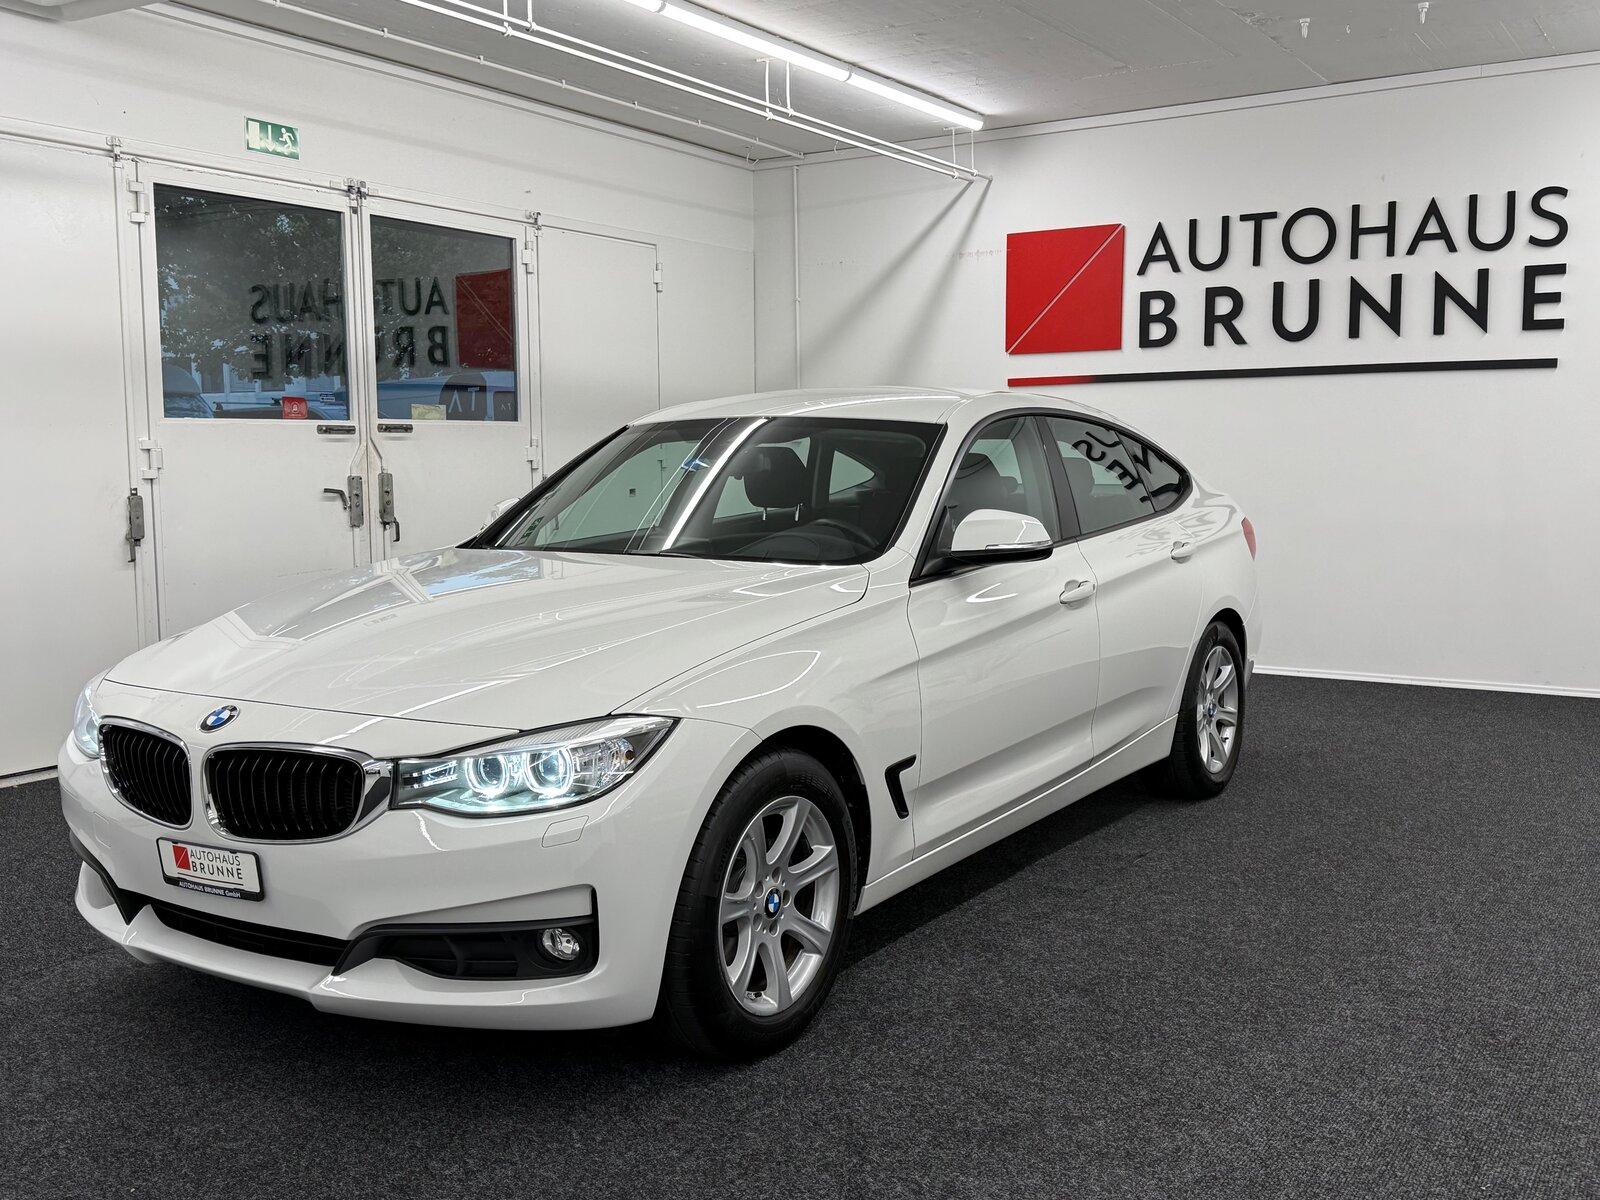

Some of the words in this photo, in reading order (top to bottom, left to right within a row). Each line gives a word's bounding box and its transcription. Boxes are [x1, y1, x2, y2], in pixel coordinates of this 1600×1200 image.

[1137, 186, 1569, 276] AUTOHAUS
[1138, 262, 1567, 349] BRUNNE
[190, 849, 241, 866] AUTOHAUS
[191, 861, 243, 880] BRUNNE
[179, 881, 204, 891] AUTOHAUS
[204, 886, 225, 896] BRUNNE
[225, 890, 241, 898] GmbH
